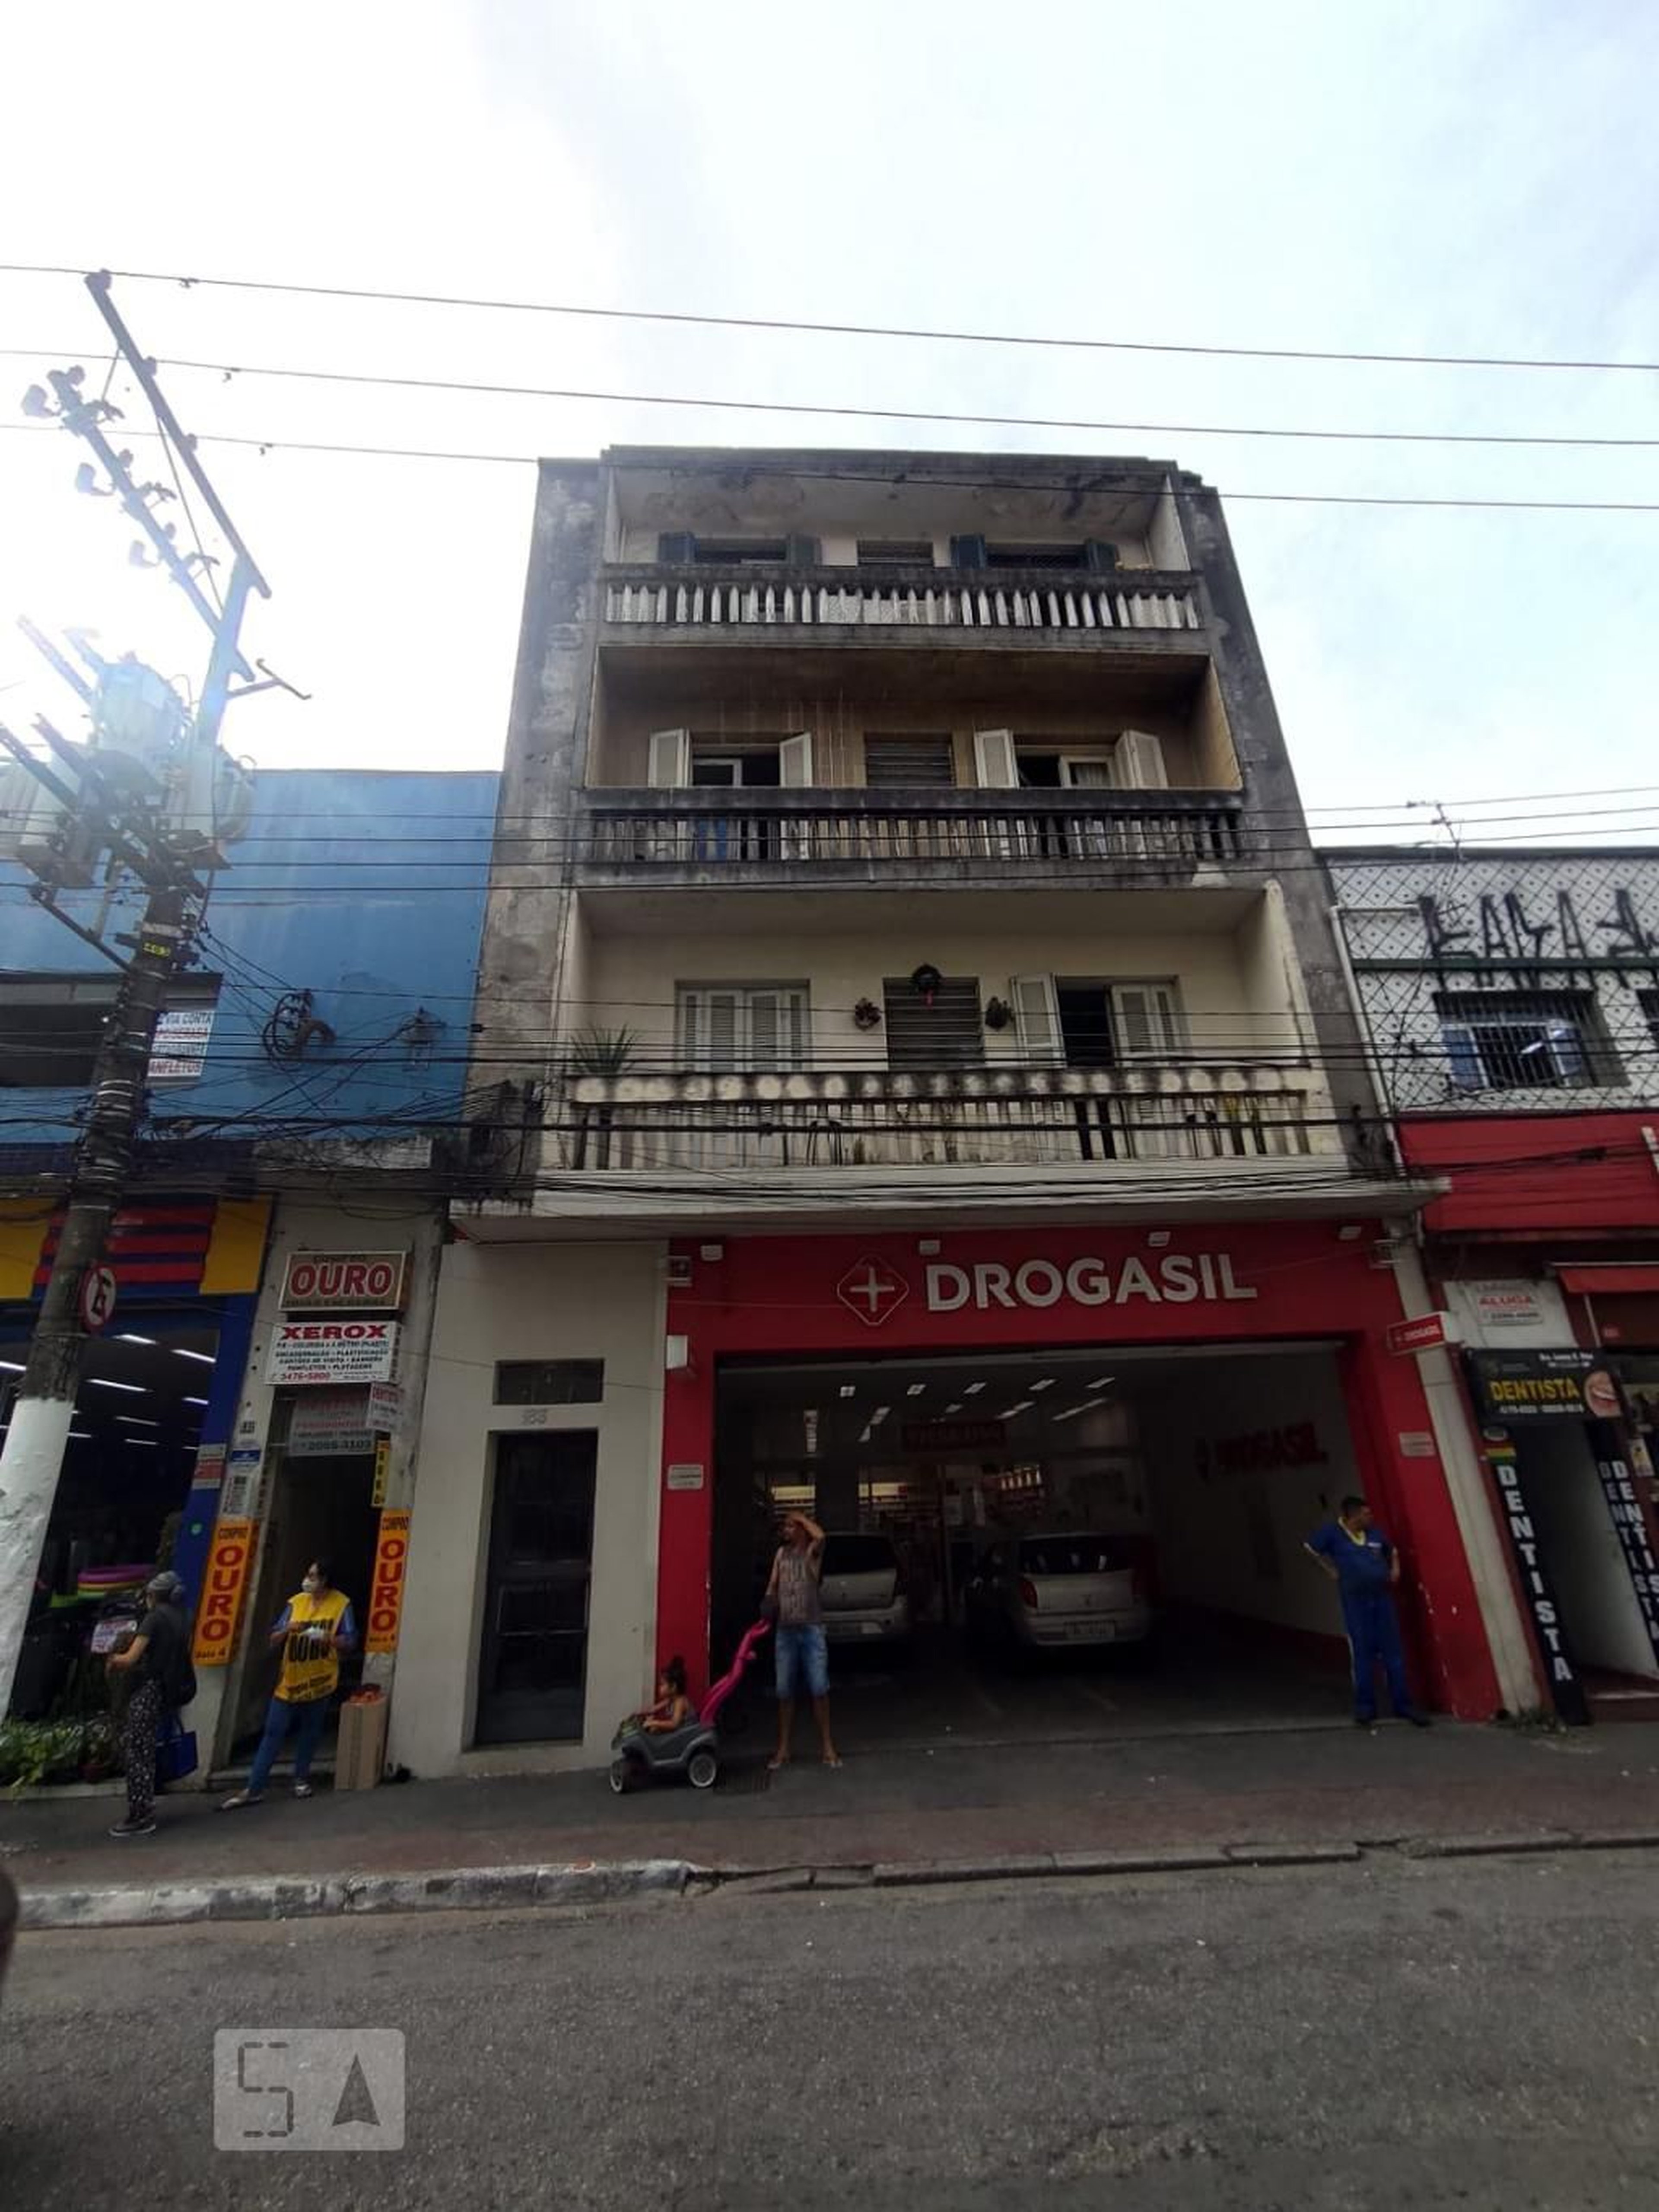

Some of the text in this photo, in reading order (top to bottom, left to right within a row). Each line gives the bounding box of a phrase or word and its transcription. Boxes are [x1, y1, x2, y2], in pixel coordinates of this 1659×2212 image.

[289, 1262, 394, 1297] OURO
[926, 1254, 1258, 1311] DROGASIL
[280, 1325, 387, 1340] XEROX
[1489, 1377, 1581, 1401] DENTISTA
[1612, 1460, 1659, 1604] DENTIS
[202, 1546, 244, 1642] OURO
[371, 1539, 405, 1632] OURO
[1497, 1465, 1573, 1680] DENTISTA
